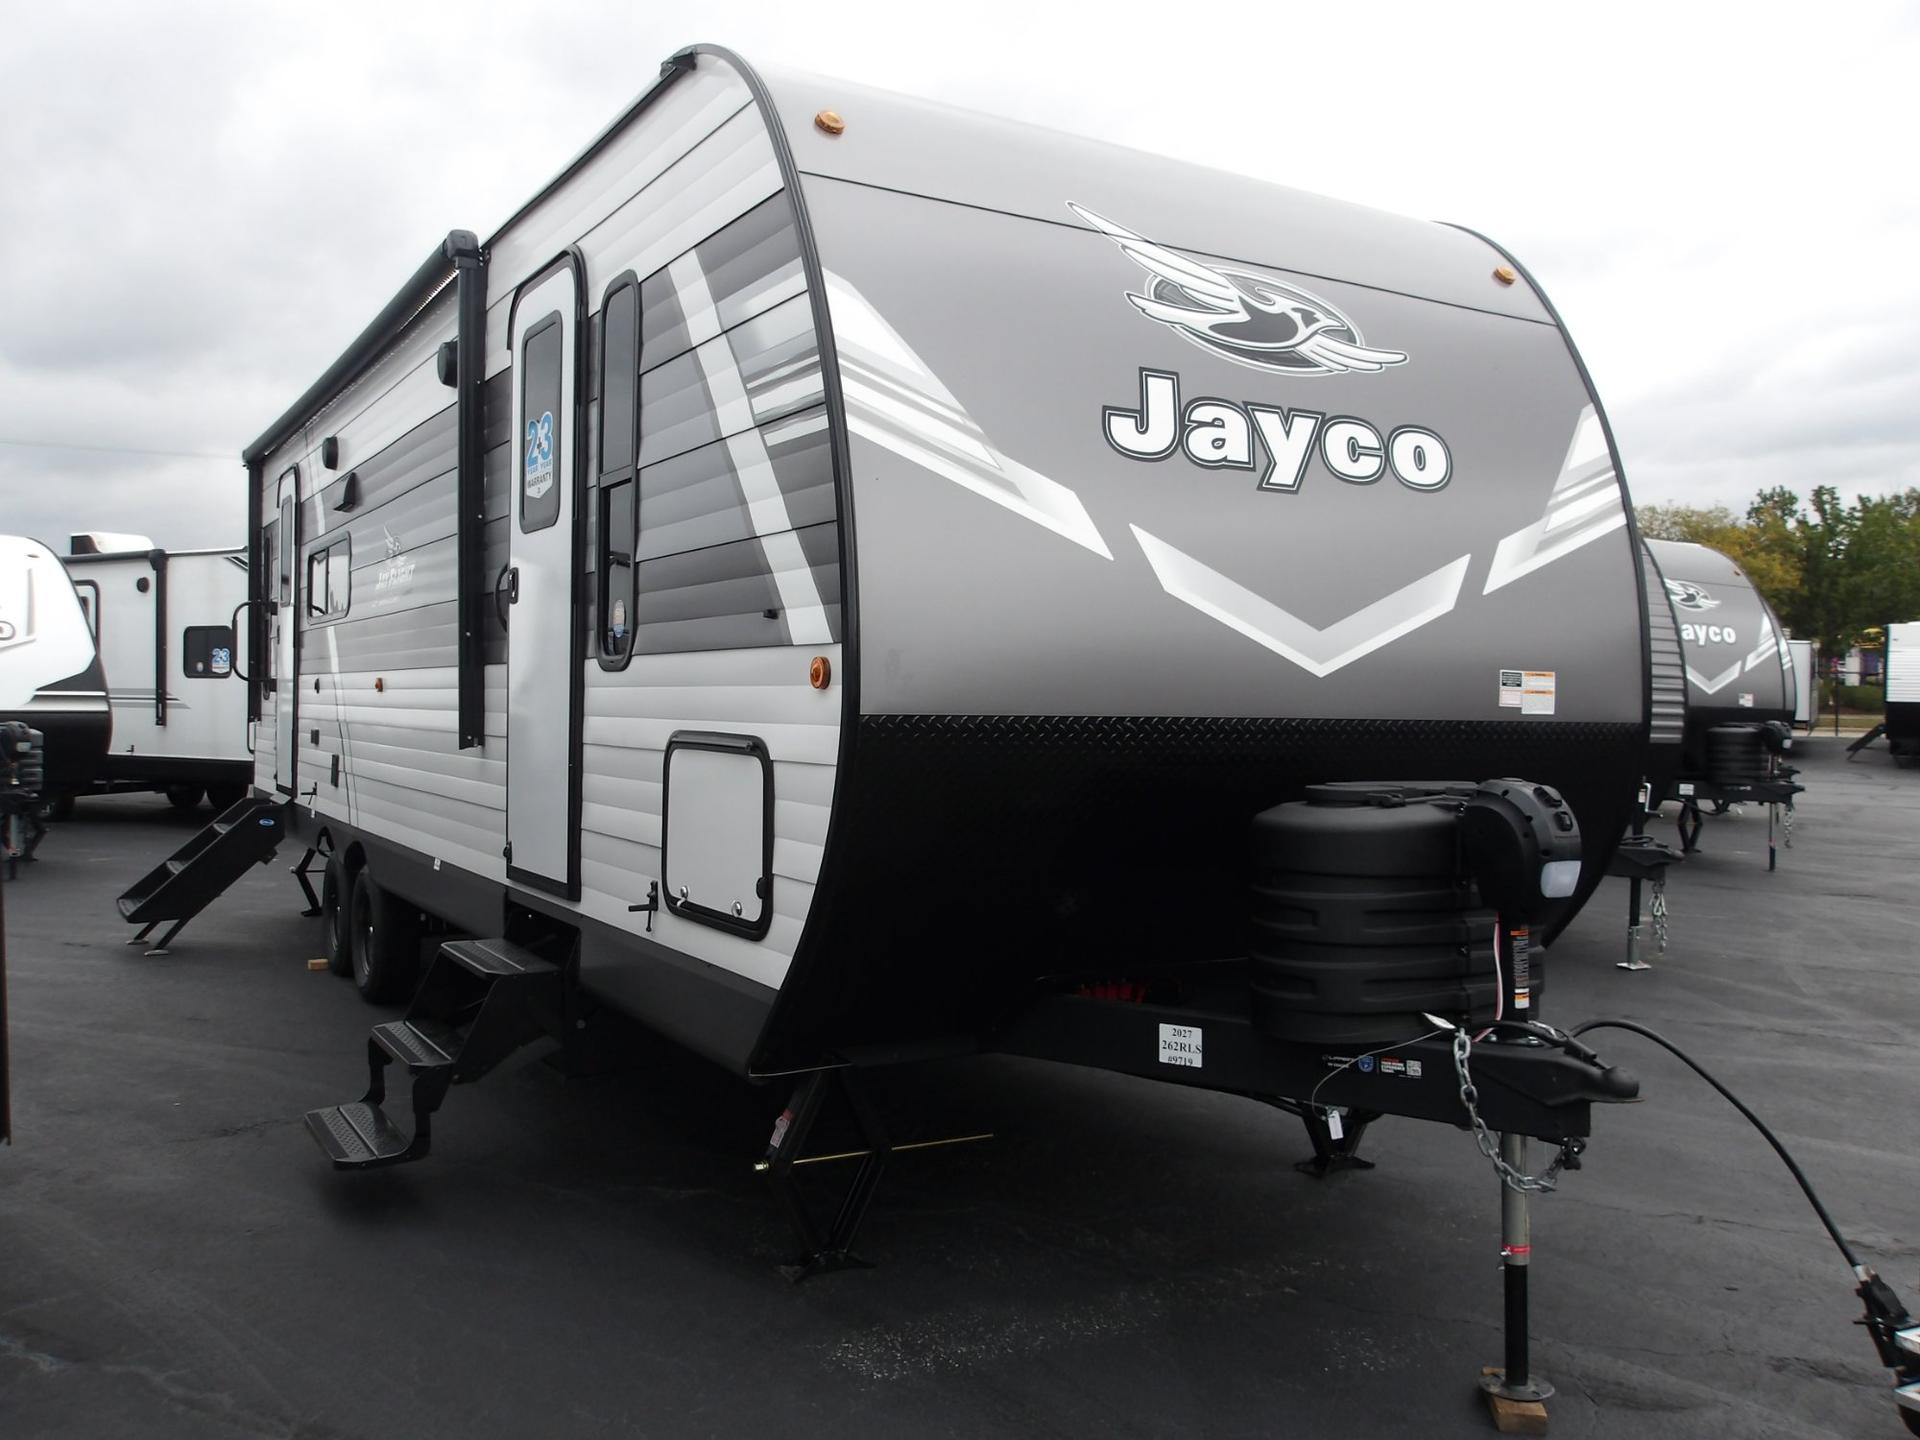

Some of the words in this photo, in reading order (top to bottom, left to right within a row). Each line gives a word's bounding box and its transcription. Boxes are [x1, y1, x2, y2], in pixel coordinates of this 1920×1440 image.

[1102, 367, 1453, 494] Jayco
[1681, 623, 1737, 646] ayco
[1172, 1028, 1192, 1038] 2027
[1162, 1040, 1202, 1054] 262RLS
[1168, 1056, 1193, 1066] #9719
